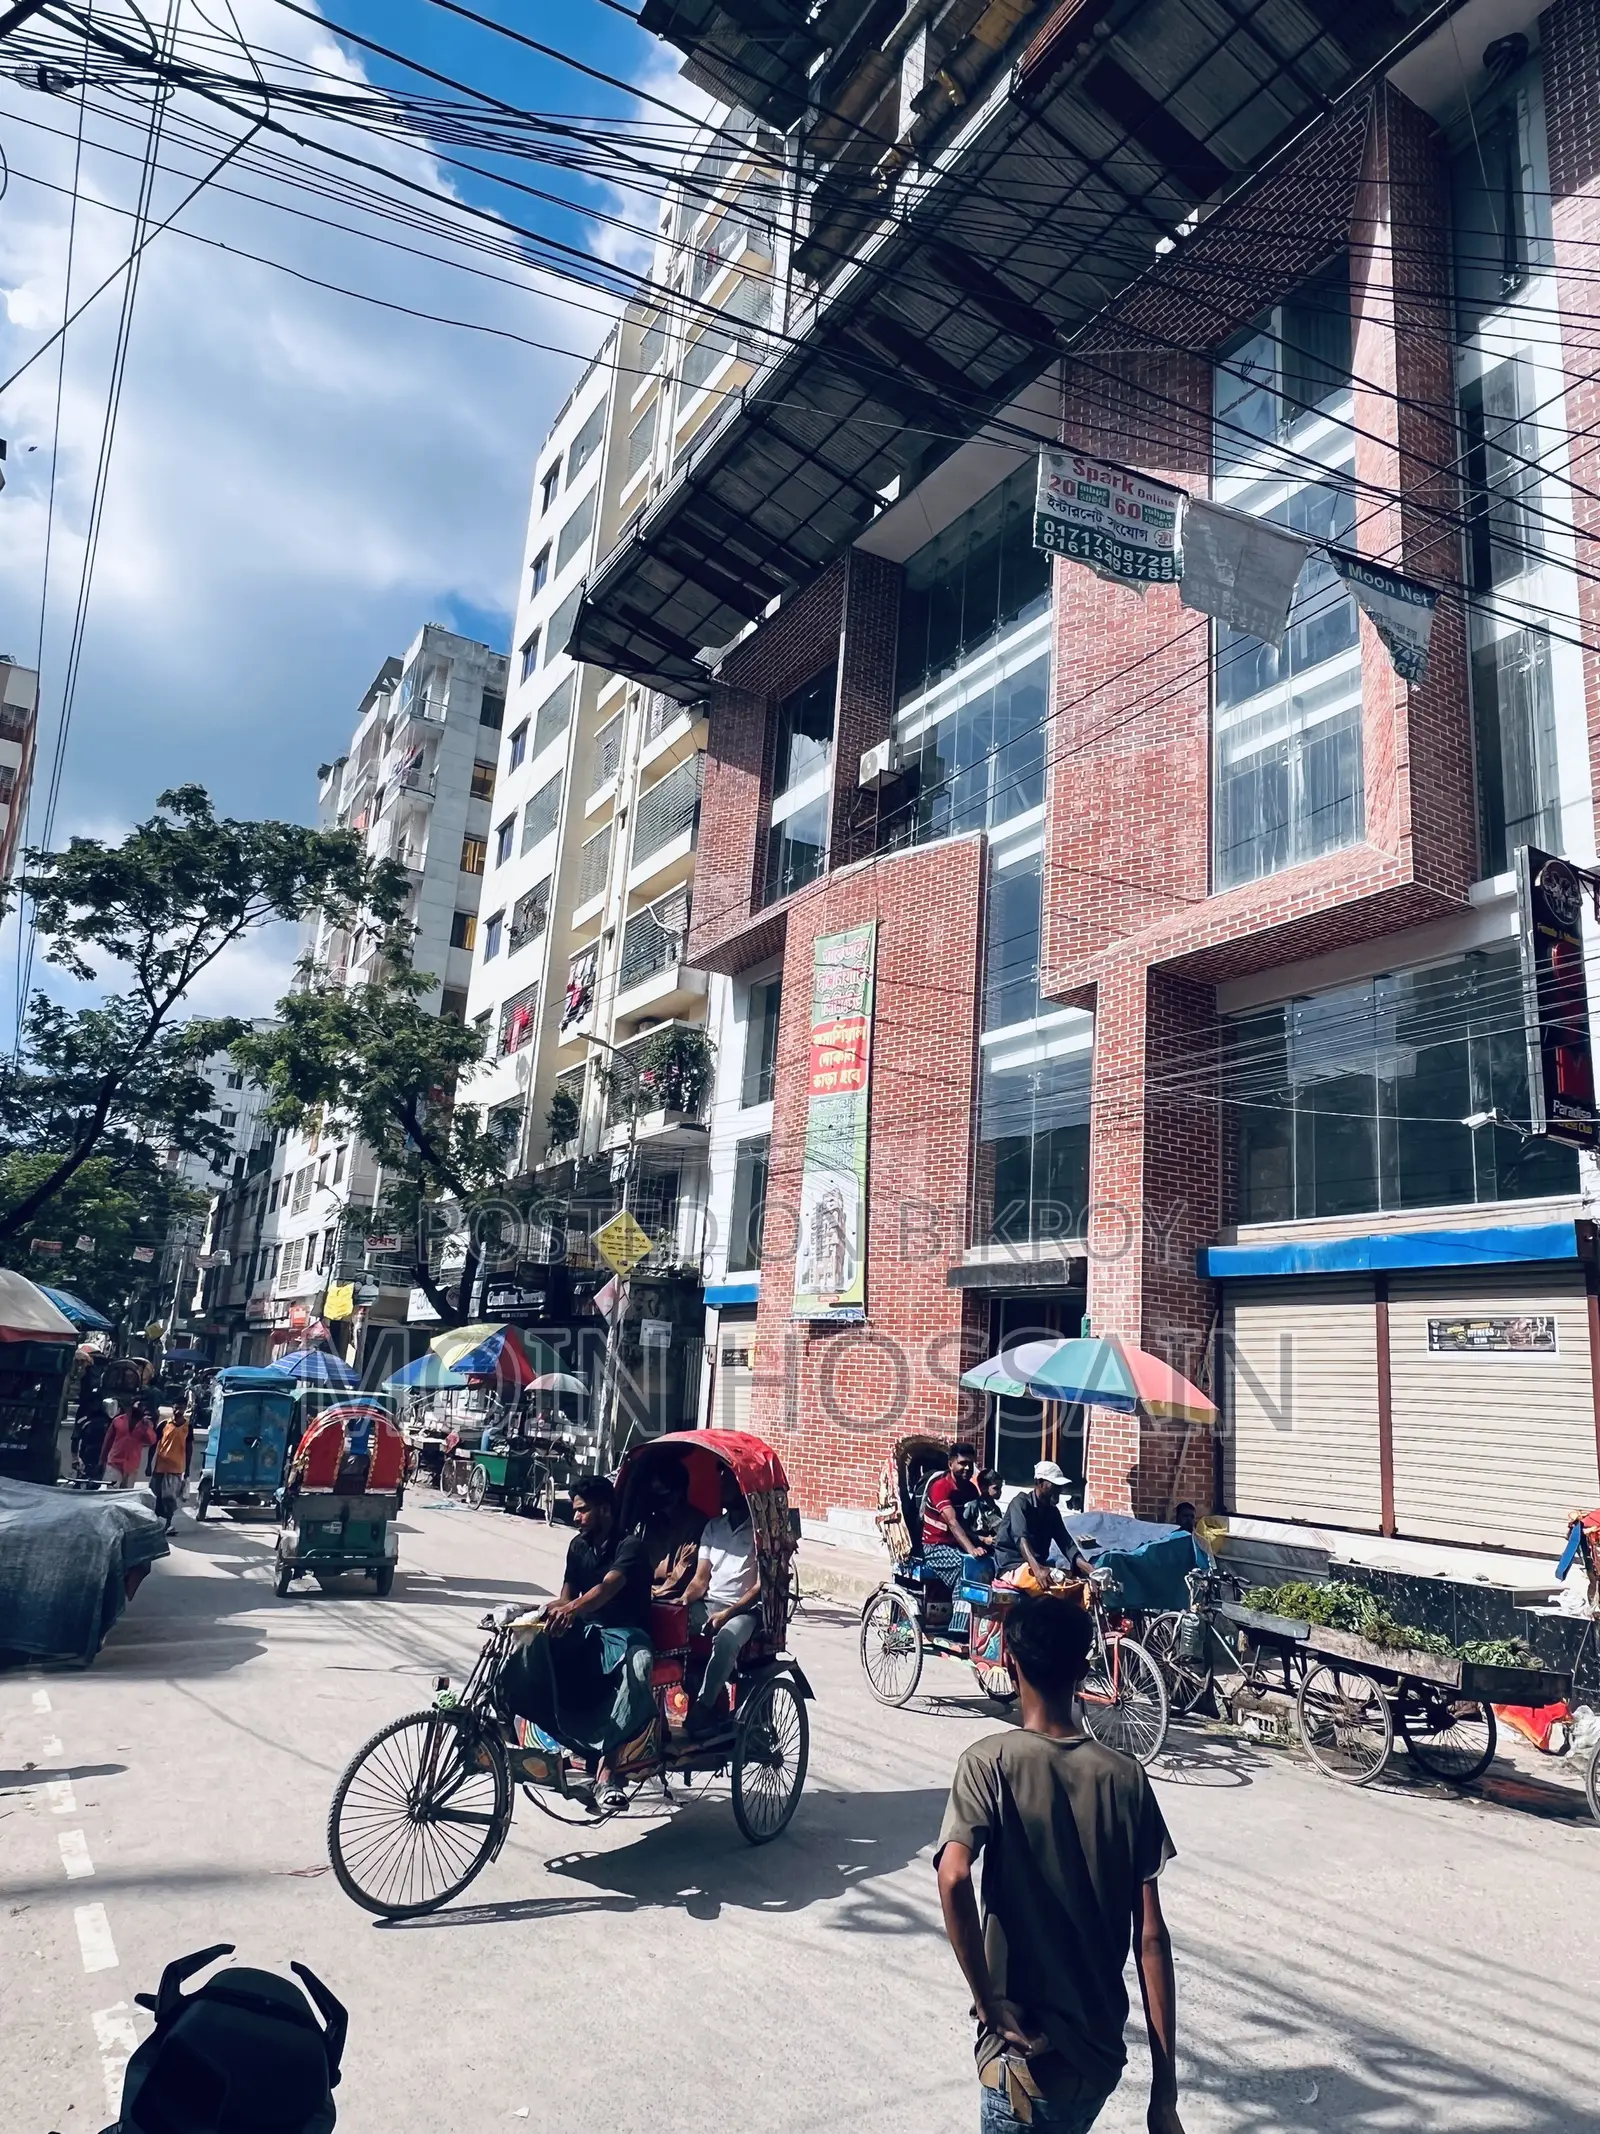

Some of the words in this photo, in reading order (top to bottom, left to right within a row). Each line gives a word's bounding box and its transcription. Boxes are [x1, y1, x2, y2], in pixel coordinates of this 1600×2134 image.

[1048, 474, 1077, 497] 20
[1072, 457, 1135, 496] Spark
[1138, 488, 1176, 508] Online
[1114, 492, 1141, 519] 60
[1348, 562, 1396, 594] Moon
[1400, 583, 1433, 607] Net
[819, 1048, 857, 1068] দোকান
[812, 1071, 839, 1090] ভাড়া
[840, 1068, 861, 1085] হবে
[1553, 1099, 1592, 1119] Paradise
